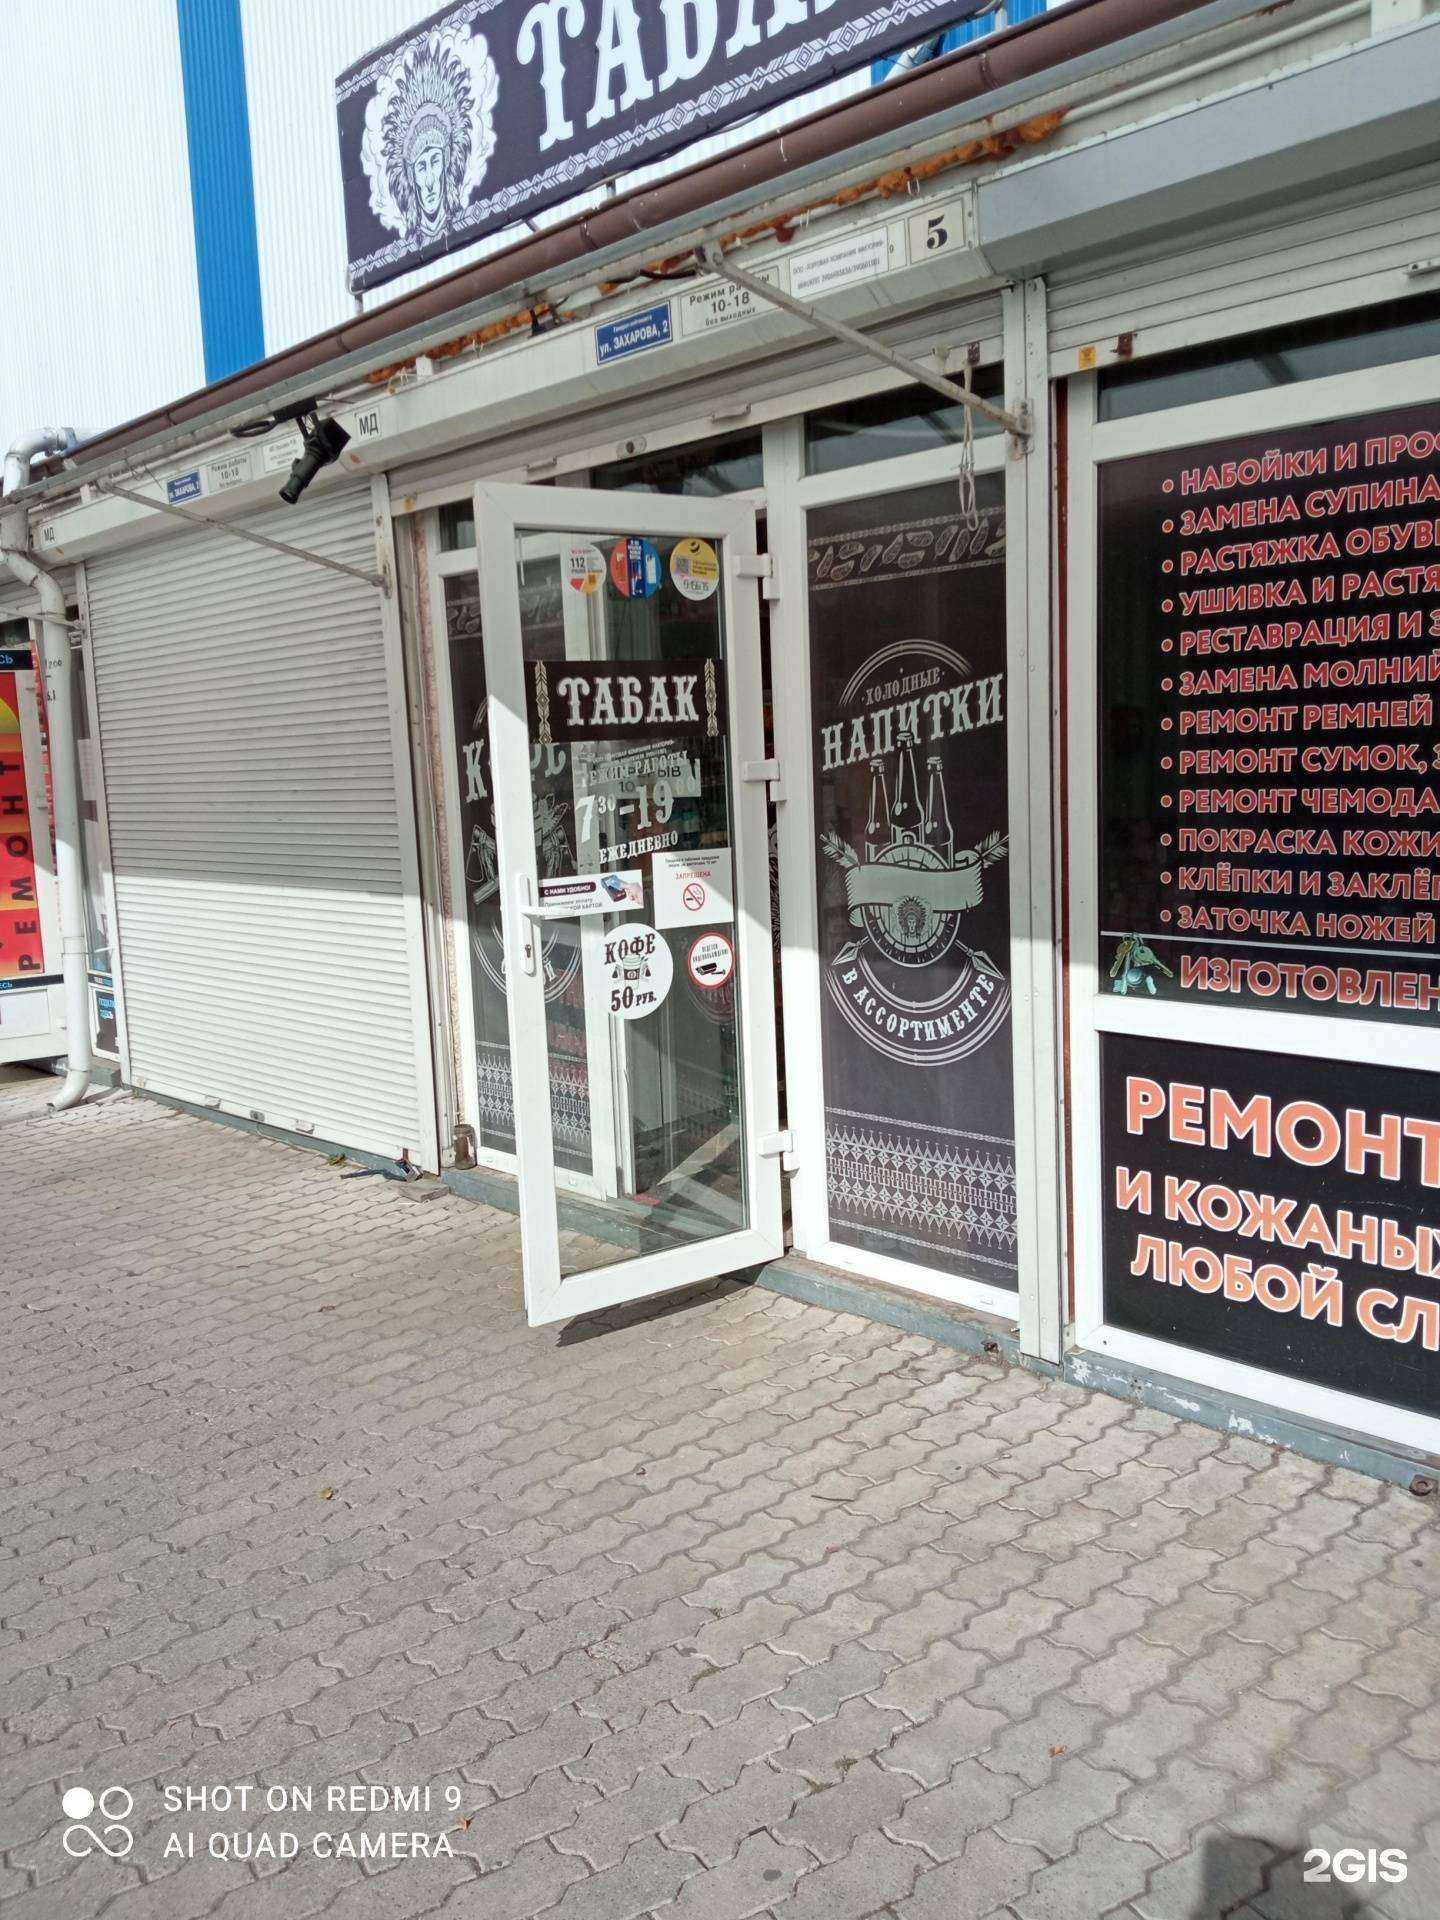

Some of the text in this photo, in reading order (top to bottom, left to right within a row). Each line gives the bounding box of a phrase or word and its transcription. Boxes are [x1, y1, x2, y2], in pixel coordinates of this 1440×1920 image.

[516, 0, 838, 151] ТАБ
[926, 214, 948, 249] 5
[689, 274, 769, 306] Режим раы
[711, 291, 750, 314] 10-18
[599, 342, 612, 358] ул.
[613, 323, 661, 350] ЗАХАРОВА,
[662, 320, 669, 333] 2
[358, 411, 379, 436] МД
[1180, 447, 1326, 495] НАБОЙКИ
[1334, 442, 1358, 471] И
[1179, 473, 1440, 536] ЗАМЕНА СУПИНА
[1180, 519, 1440, 576] РАСТЯЖКА ОБУВ
[1178, 579, 1307, 617] УШИВКА
[1312, 575, 1335, 604] И
[1179, 612, 1391, 656] РЕСТАВРАЦИЯ
[1398, 610, 1422, 638] И
[865, 667, 941, 706] ХОЛОДНЫЕ
[1178, 664, 1299, 696] ЗАМЕНА
[557, 675, 699, 727] ТАБАК
[1179, 694, 1433, 735] РЕМОНТ РЕМНЕЙ
[821, 673, 1004, 772] НАПИТКИ
[1178, 747, 1298, 774] РЕМОНТ
[1301, 744, 1429, 774] СУМОК,
[1178, 786, 1440, 817] РЕМОНТ ЧЕМОДА
[599, 830, 679, 865] ЕЖЕДНЕВНО
[1178, 828, 1440, 857] ПОКРАСКА КОЖИ
[1178, 862, 1292, 894] КЛЁПКИ
[1299, 871, 1321, 896] И
[1177, 905, 1436, 944] ЗАТОЧКА НОЖЕЙ
[604, 932, 656, 965] КОФЕ
[611, 986, 657, 1012] 50 РУБ.
[842, 967, 995, 1042] В АССОРТИМЕНТЕ
[1126, 1075, 1440, 1188] РЕМОНТ
[1116, 1165, 1440, 1279] И КОЖАНЫ
[1130, 1233, 1440, 1351] ЛЮБОЙ СЛ
